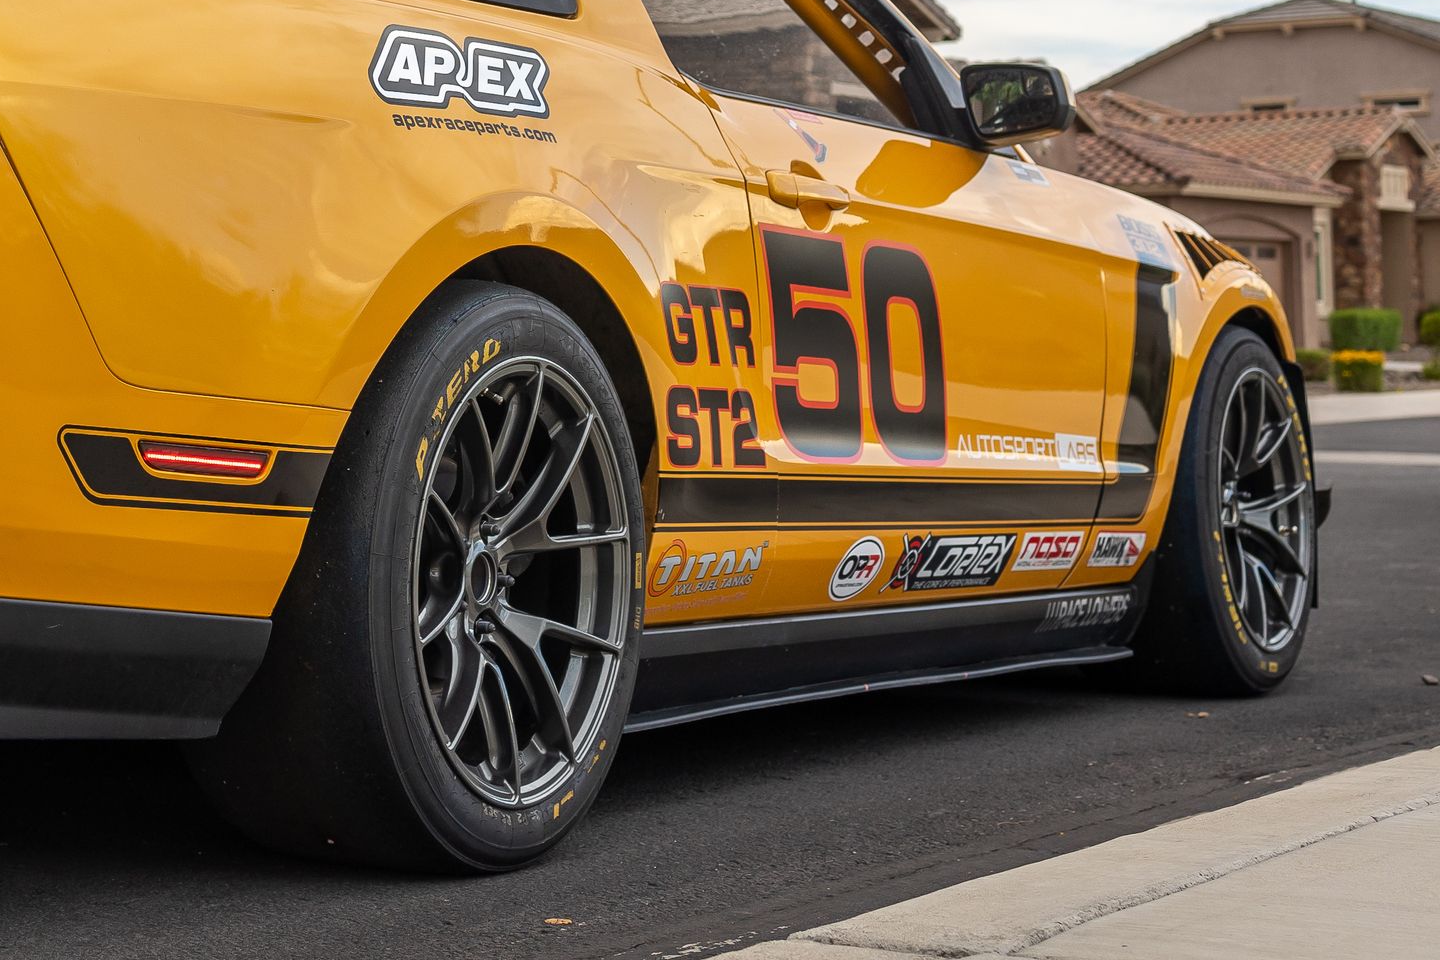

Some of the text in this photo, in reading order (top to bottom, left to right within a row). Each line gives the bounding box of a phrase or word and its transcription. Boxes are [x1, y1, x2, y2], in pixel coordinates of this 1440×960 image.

[387, 43, 535, 101] APEX
[392, 113, 558, 144] apexraceparts.com
[660, 280, 756, 368] GTR
[758, 222, 948, 467] 50
[665, 385, 767, 468] ST2
[657, 546, 763, 585] TITAN
